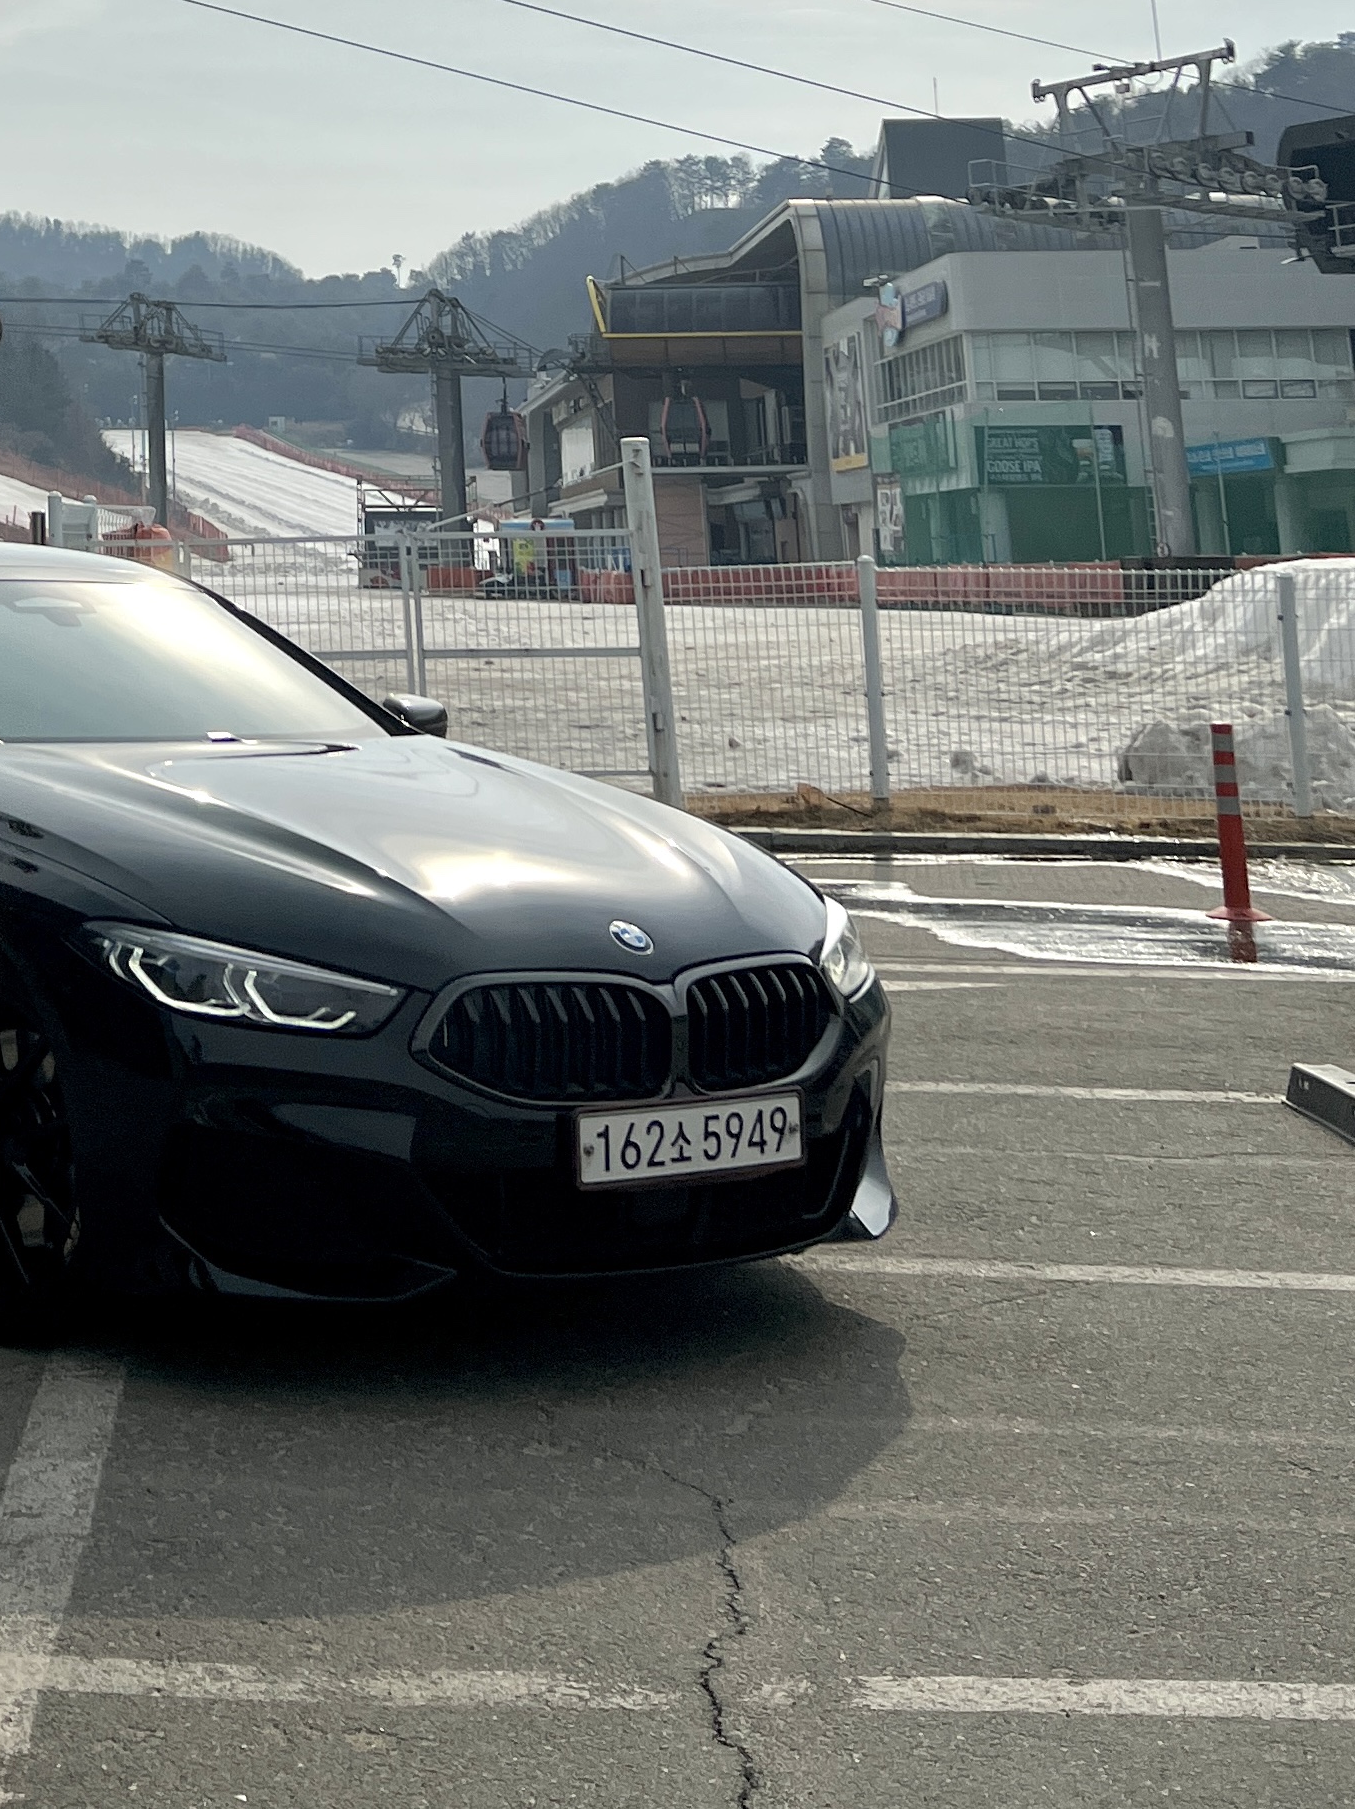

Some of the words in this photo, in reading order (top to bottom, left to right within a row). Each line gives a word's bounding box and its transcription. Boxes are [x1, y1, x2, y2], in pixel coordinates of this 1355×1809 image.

[987, 460, 1021, 474] GOOSE
[1023, 460, 1043, 474] IPA
[596, 1119, 693, 1173] 162소
[702, 1105, 789, 1162] 5949
